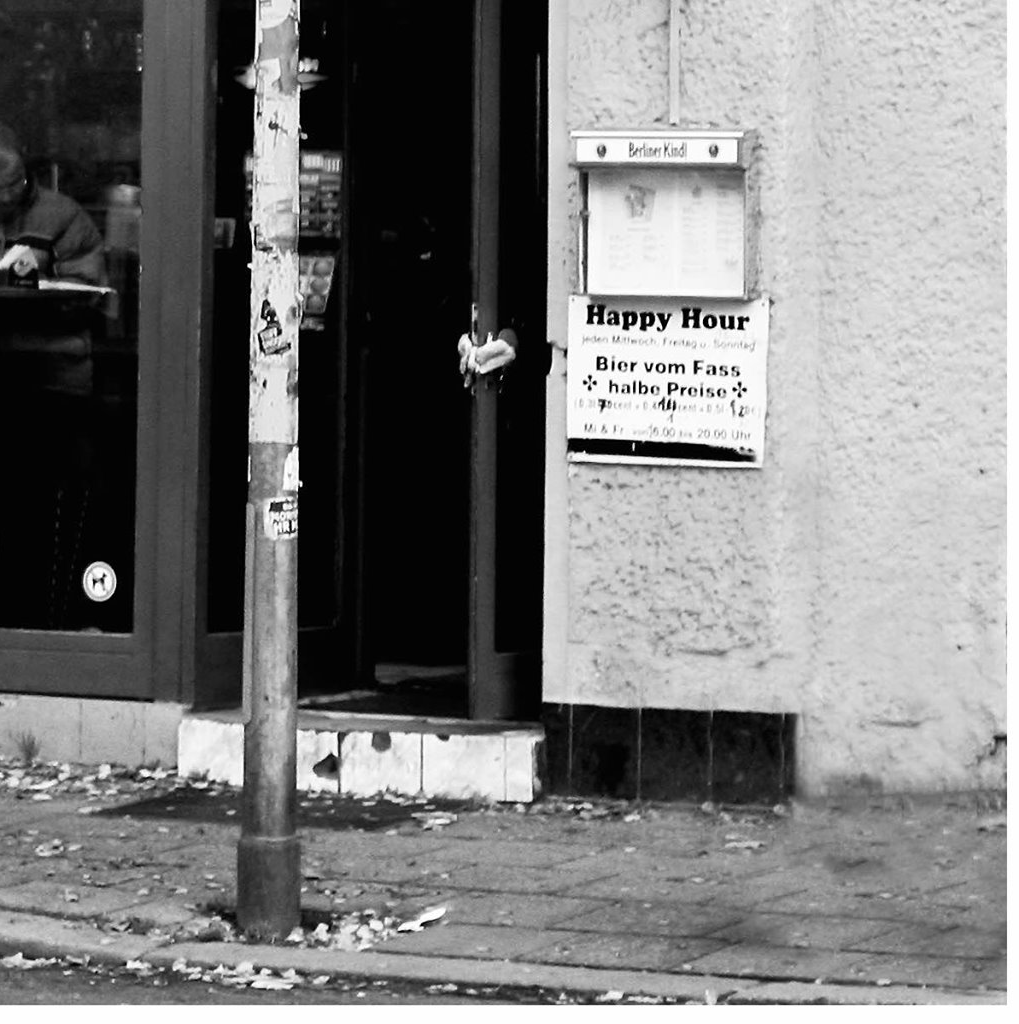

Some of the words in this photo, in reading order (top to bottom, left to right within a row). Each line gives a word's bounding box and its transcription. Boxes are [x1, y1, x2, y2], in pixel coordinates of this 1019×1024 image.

[629, 142, 662, 158] Berliner
[663, 142, 687, 158] Kindl
[586, 304, 672, 332] Happy
[681, 307, 750, 330] Hour
[596, 355, 637, 372] Bier
[644, 361, 686, 375] vom
[693, 359, 741, 377] Fass
[608, 379, 660, 396] halbe
[667, 381, 727, 398] Preise
[731, 429, 751, 441] Uhr
